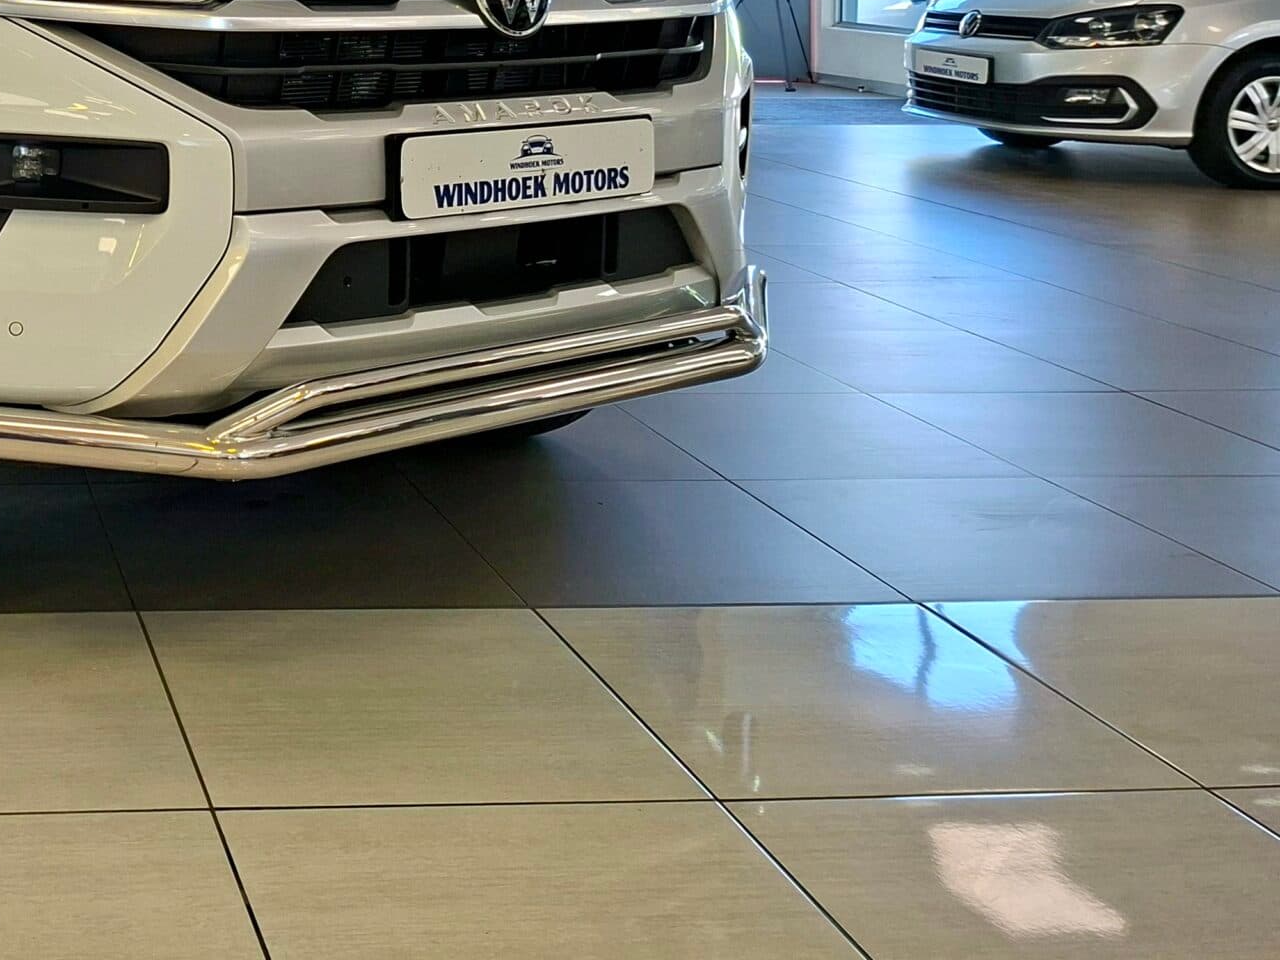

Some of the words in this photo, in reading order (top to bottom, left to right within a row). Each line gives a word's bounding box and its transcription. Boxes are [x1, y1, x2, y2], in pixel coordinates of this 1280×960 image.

[954, 69, 979, 81] MOTORS
[433, 95, 601, 125] AMAROK
[510, 161, 540, 171] WINDHOEK
[541, 158, 564, 167] MOTORS
[434, 174, 547, 209] WINDHOEK
[552, 166, 630, 197] MOTORS
